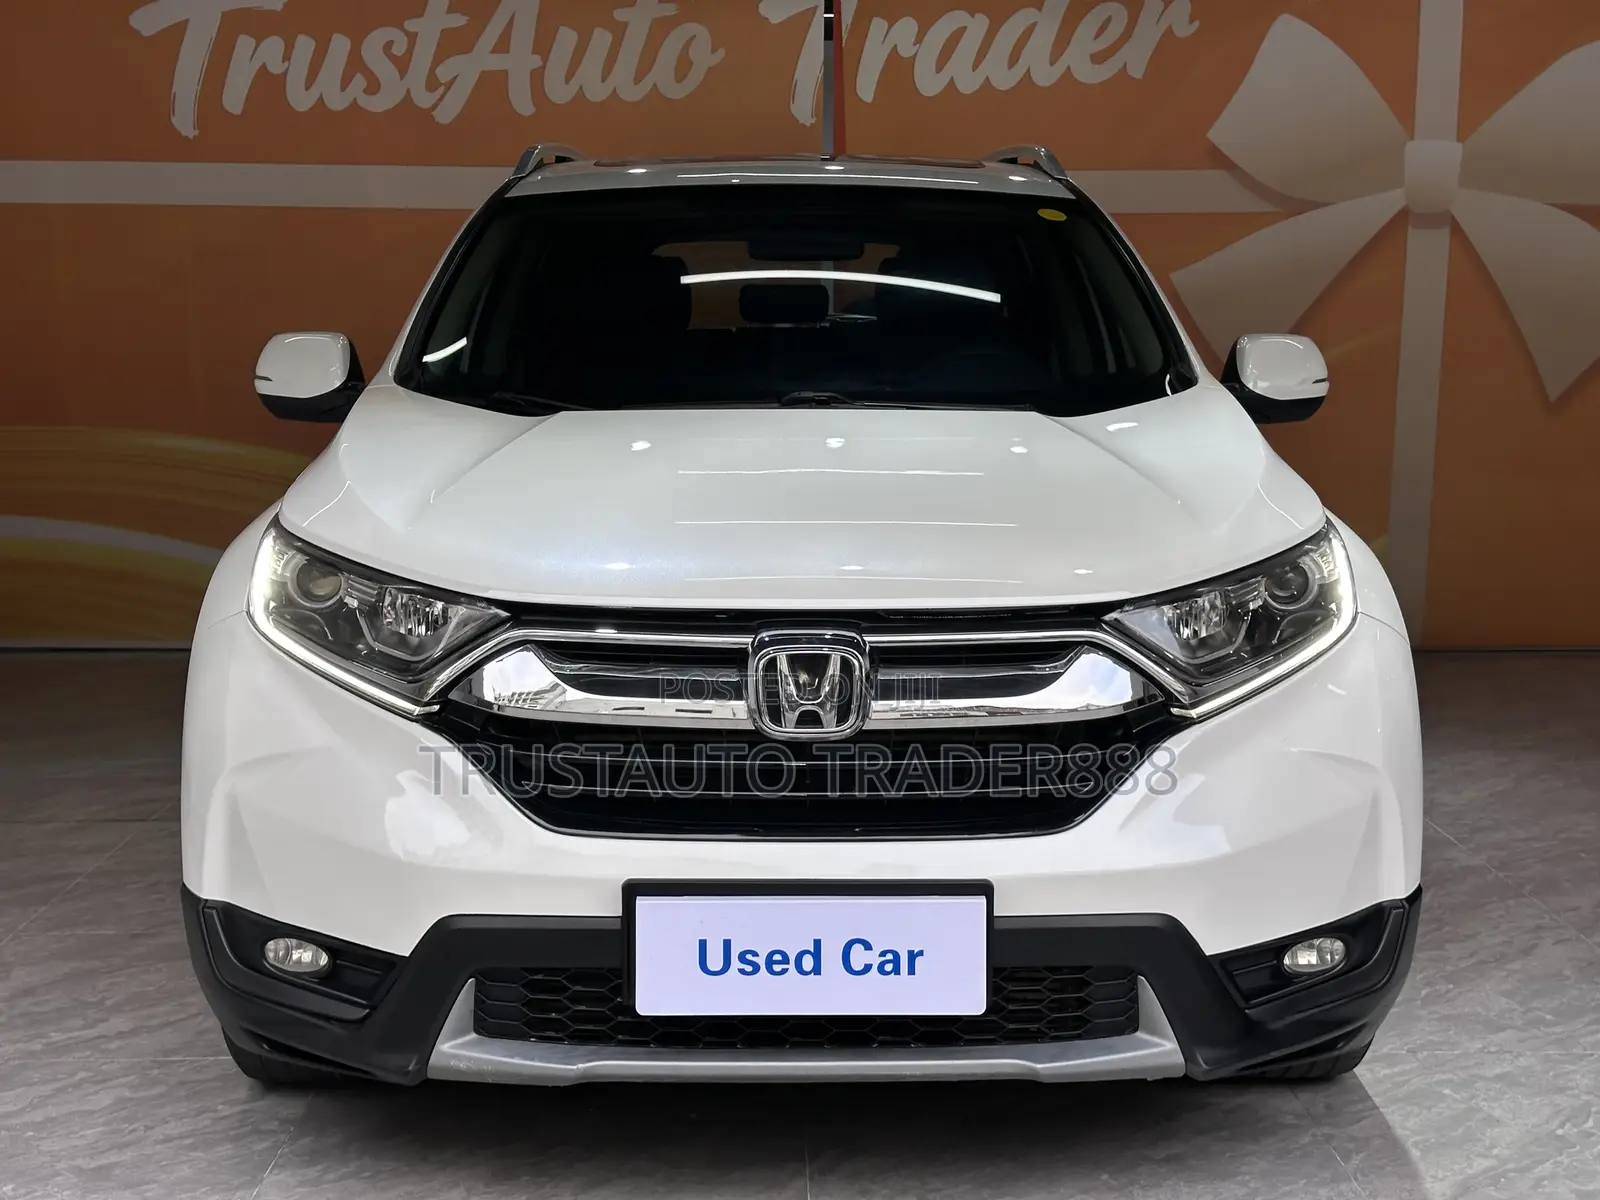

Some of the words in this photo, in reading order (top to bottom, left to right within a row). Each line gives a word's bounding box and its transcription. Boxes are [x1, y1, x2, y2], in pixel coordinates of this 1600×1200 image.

[129, 0, 726, 139] TrustAuto
[758, 0, 1199, 126] Trader
[698, 938, 822, 977] Used
[840, 937, 925, 977] Car
